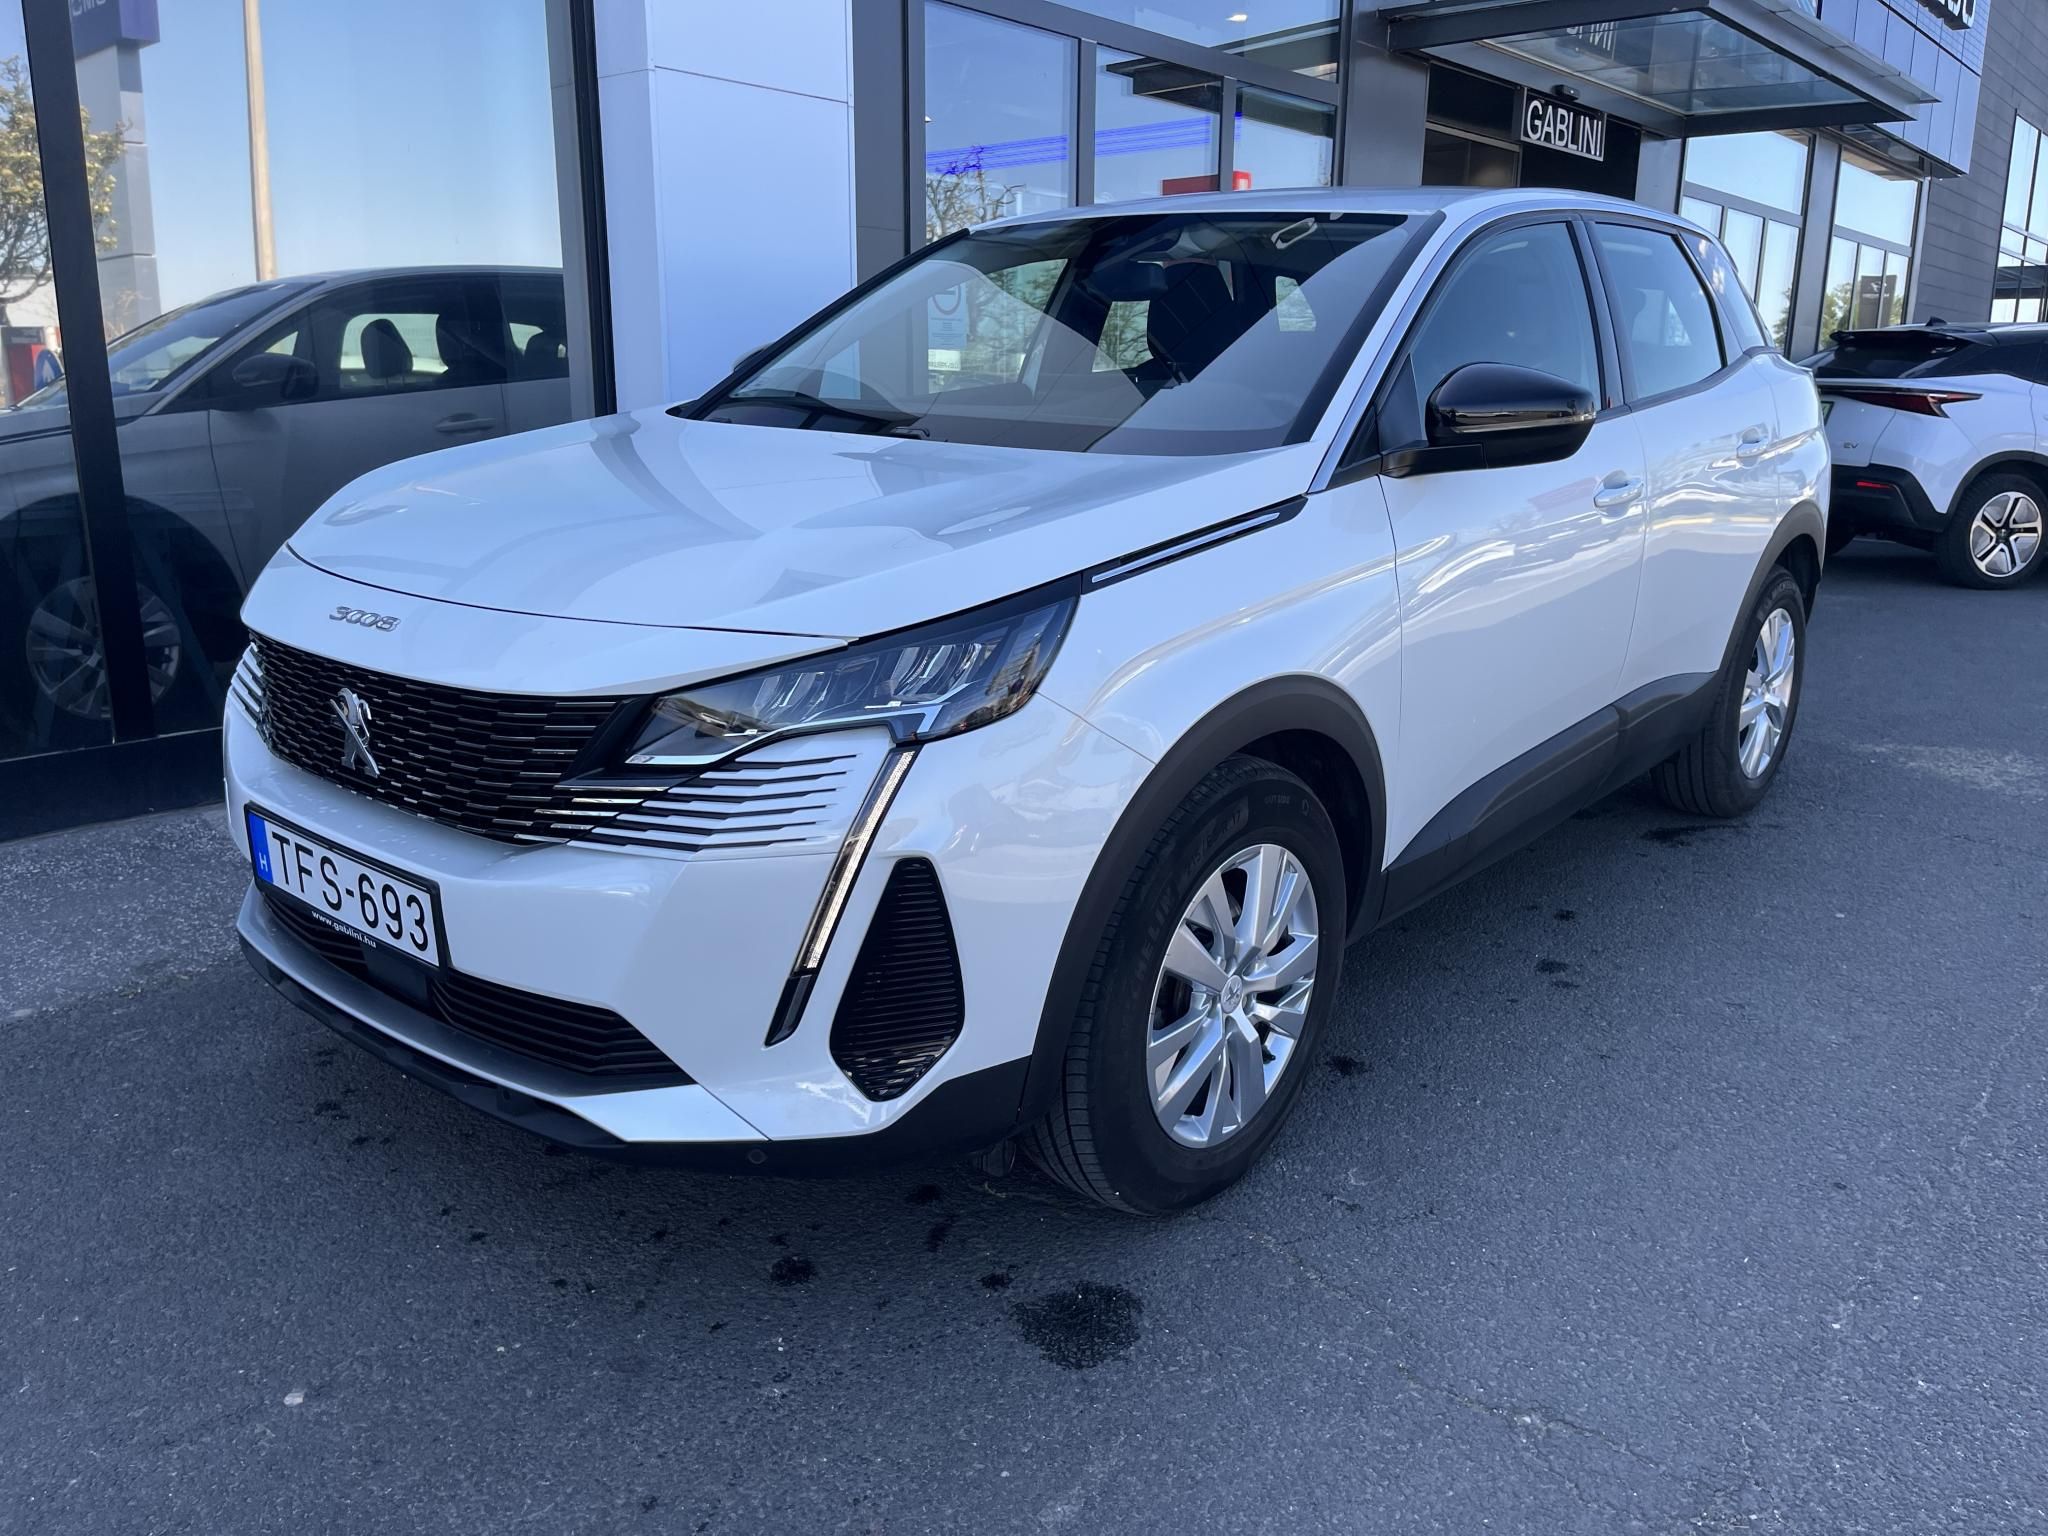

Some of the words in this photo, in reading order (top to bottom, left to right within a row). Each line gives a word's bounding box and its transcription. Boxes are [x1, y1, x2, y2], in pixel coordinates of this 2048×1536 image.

[1526, 99, 1602, 158] GABLINI
[328, 605, 402, 633] 3008
[259, 852, 269, 873] H
[271, 831, 429, 952] TFS-693
[311, 910, 377, 949] www.gablini.hu
